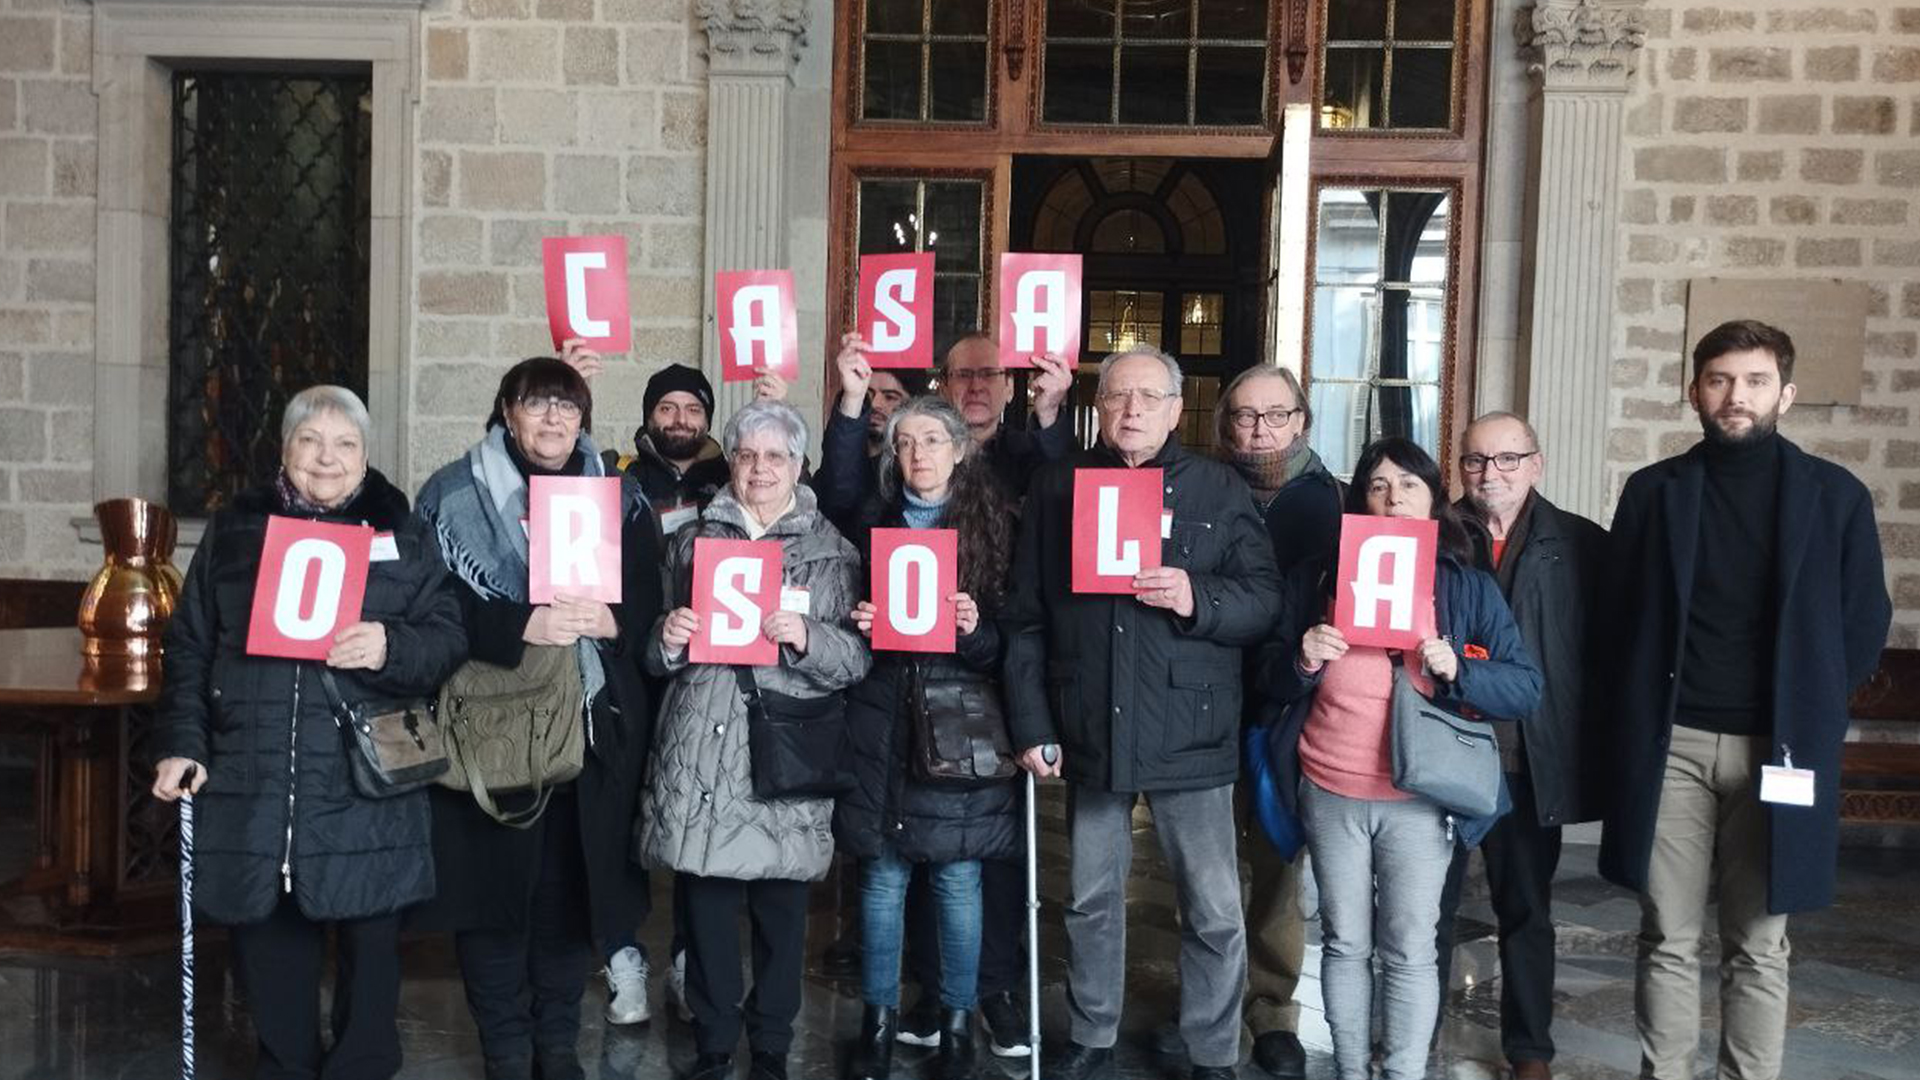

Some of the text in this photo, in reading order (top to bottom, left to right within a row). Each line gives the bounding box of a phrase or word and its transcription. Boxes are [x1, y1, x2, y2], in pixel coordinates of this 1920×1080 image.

[565, 252, 610, 338] C
[728, 284, 782, 366] A
[872, 269, 917, 353] S
[1010, 270, 1066, 353] A
[549, 494, 602, 587] R
[1097, 486, 1141, 576] L
[273, 537, 346, 641] O
[710, 556, 764, 647] S
[888, 544, 938, 636] O
[1349, 535, 1418, 632] A
